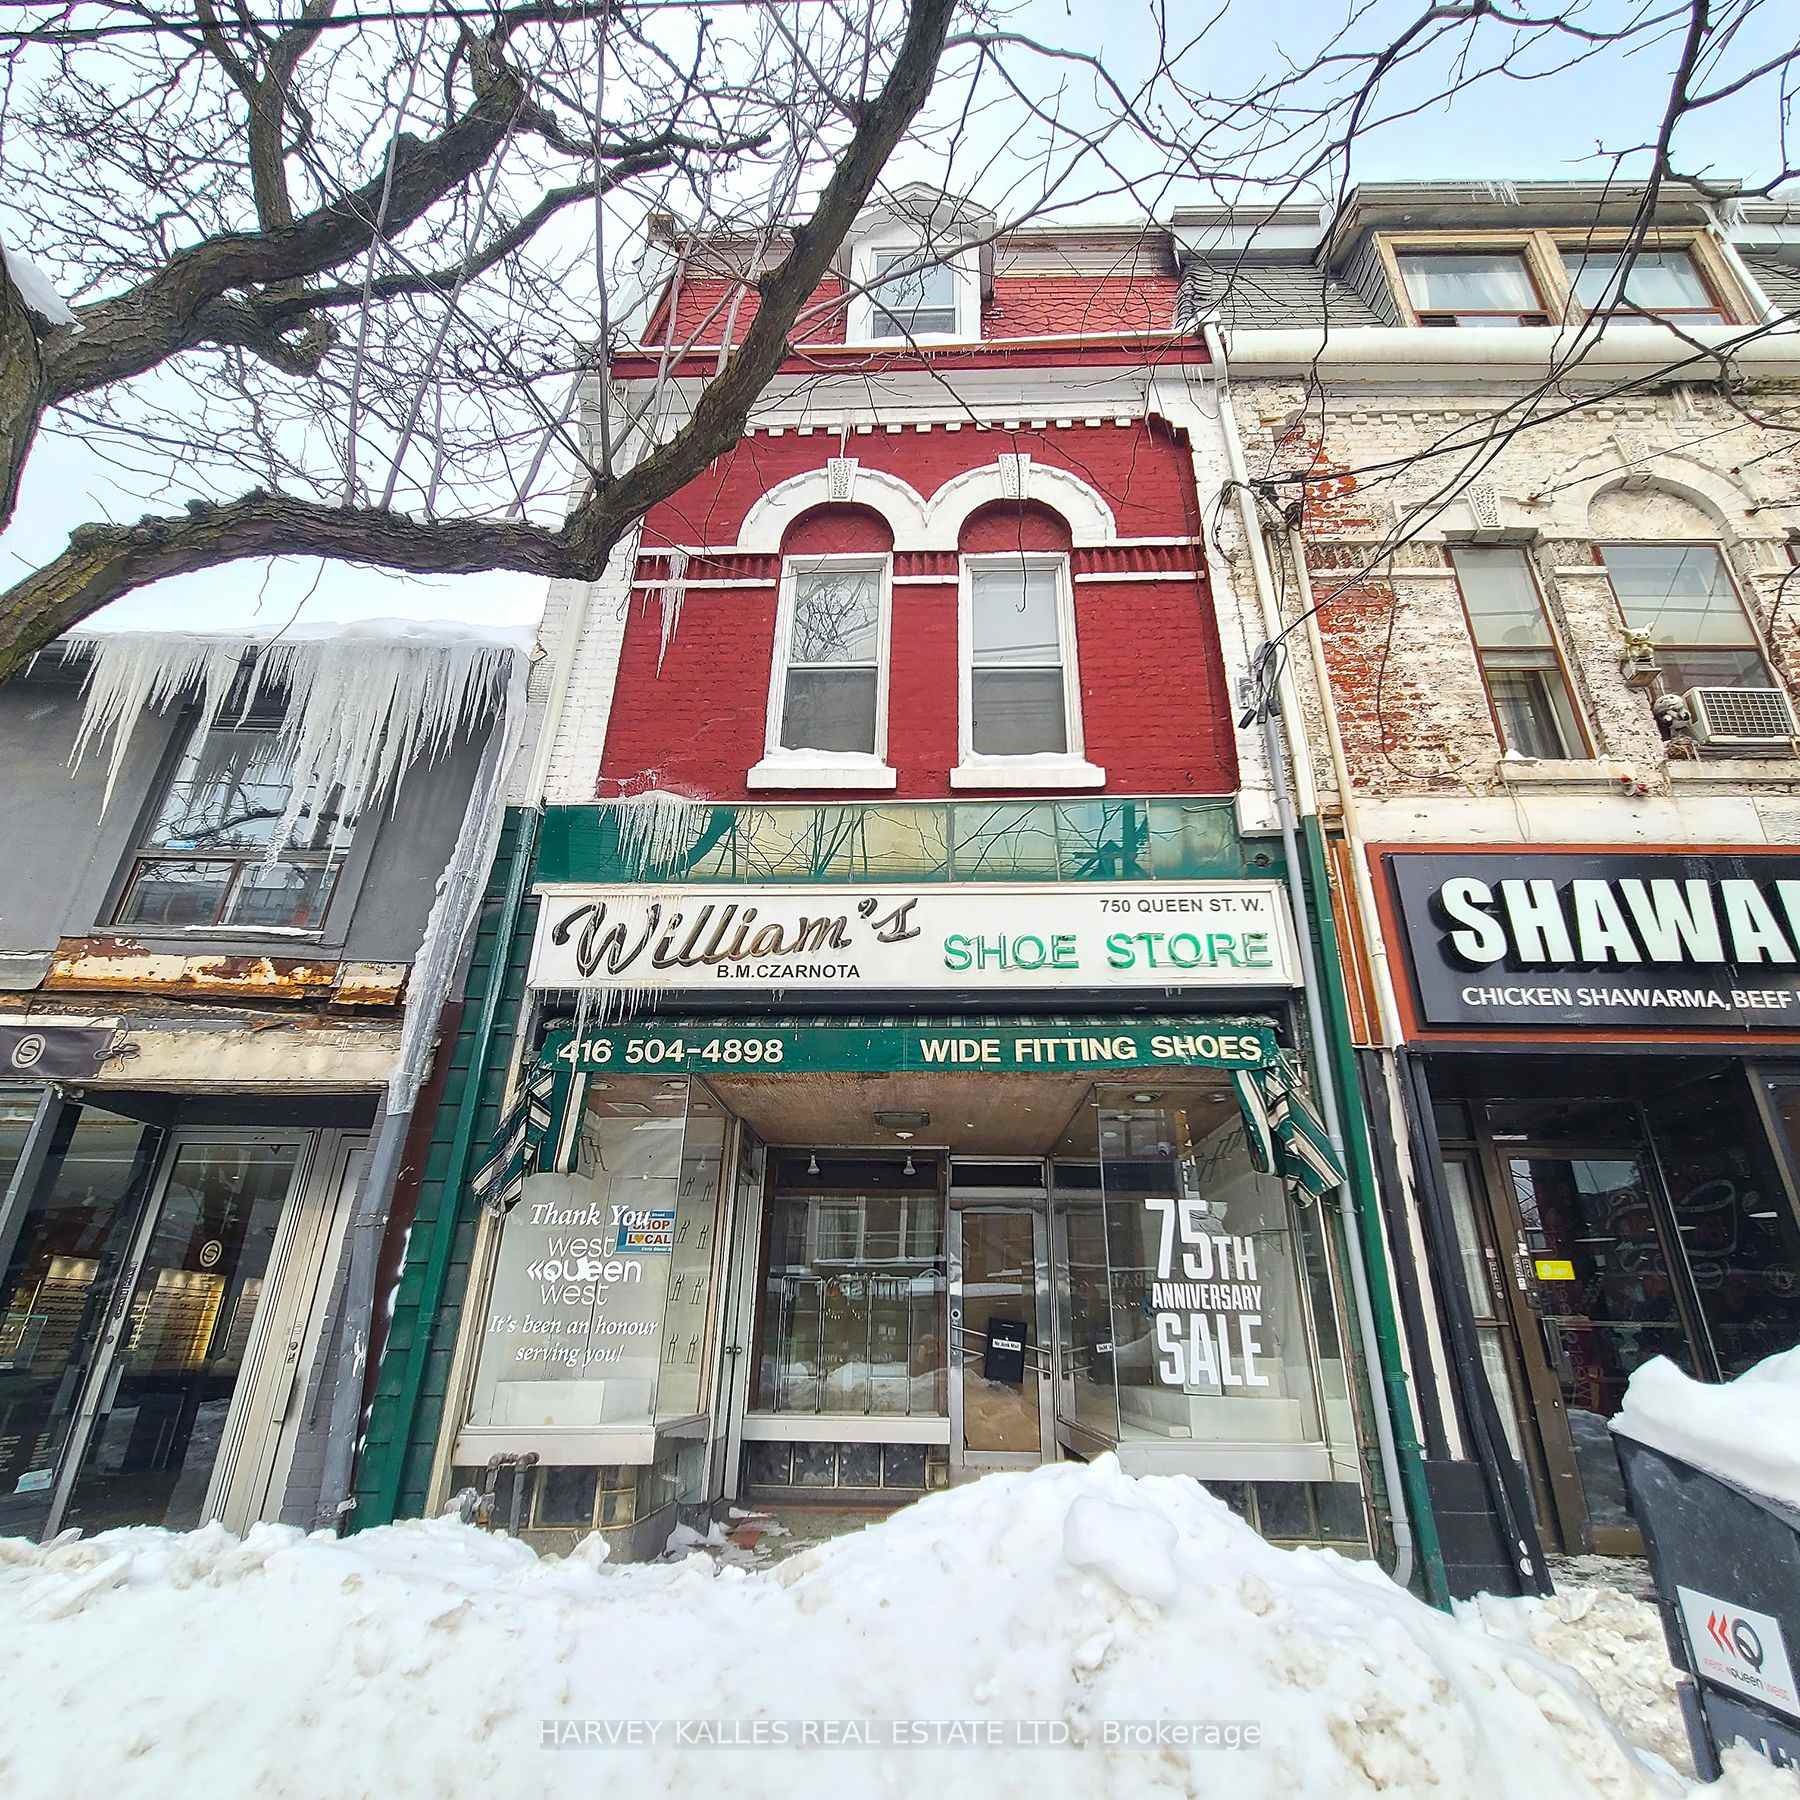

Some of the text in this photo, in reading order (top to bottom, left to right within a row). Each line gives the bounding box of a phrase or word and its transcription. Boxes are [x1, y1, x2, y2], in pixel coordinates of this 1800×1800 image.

[1100, 898, 1264, 913] 750 QUEEN ST. W.
[552, 898, 921, 977] William's
[943, 932, 1273, 970] SHOE STORE
[717, 964, 860, 979] B.M.CZARNOTA
[1462, 986, 1573, 1007] CHICKEN
[1577, 988, 1731, 1011] SHAWARMA,
[1733, 990, 1792, 1009] BEEF
[558, 1038, 784, 1063] 416 504-4898
[920, 1034, 1262, 1063] WIDE FITTING SHOES
[530, 1201, 652, 1226] Thank You
[548, 1235, 615, 1258] west
[1144, 1199, 1258, 1281] 75TH
[540, 1283, 609, 1305] west
[1152, 1282, 1262, 1311] ANNIVERSARY
[488, 1313, 658, 1337] It's been an honour
[515, 1342, 625, 1368] serving you!
[1156, 1313, 1270, 1386] SALE
